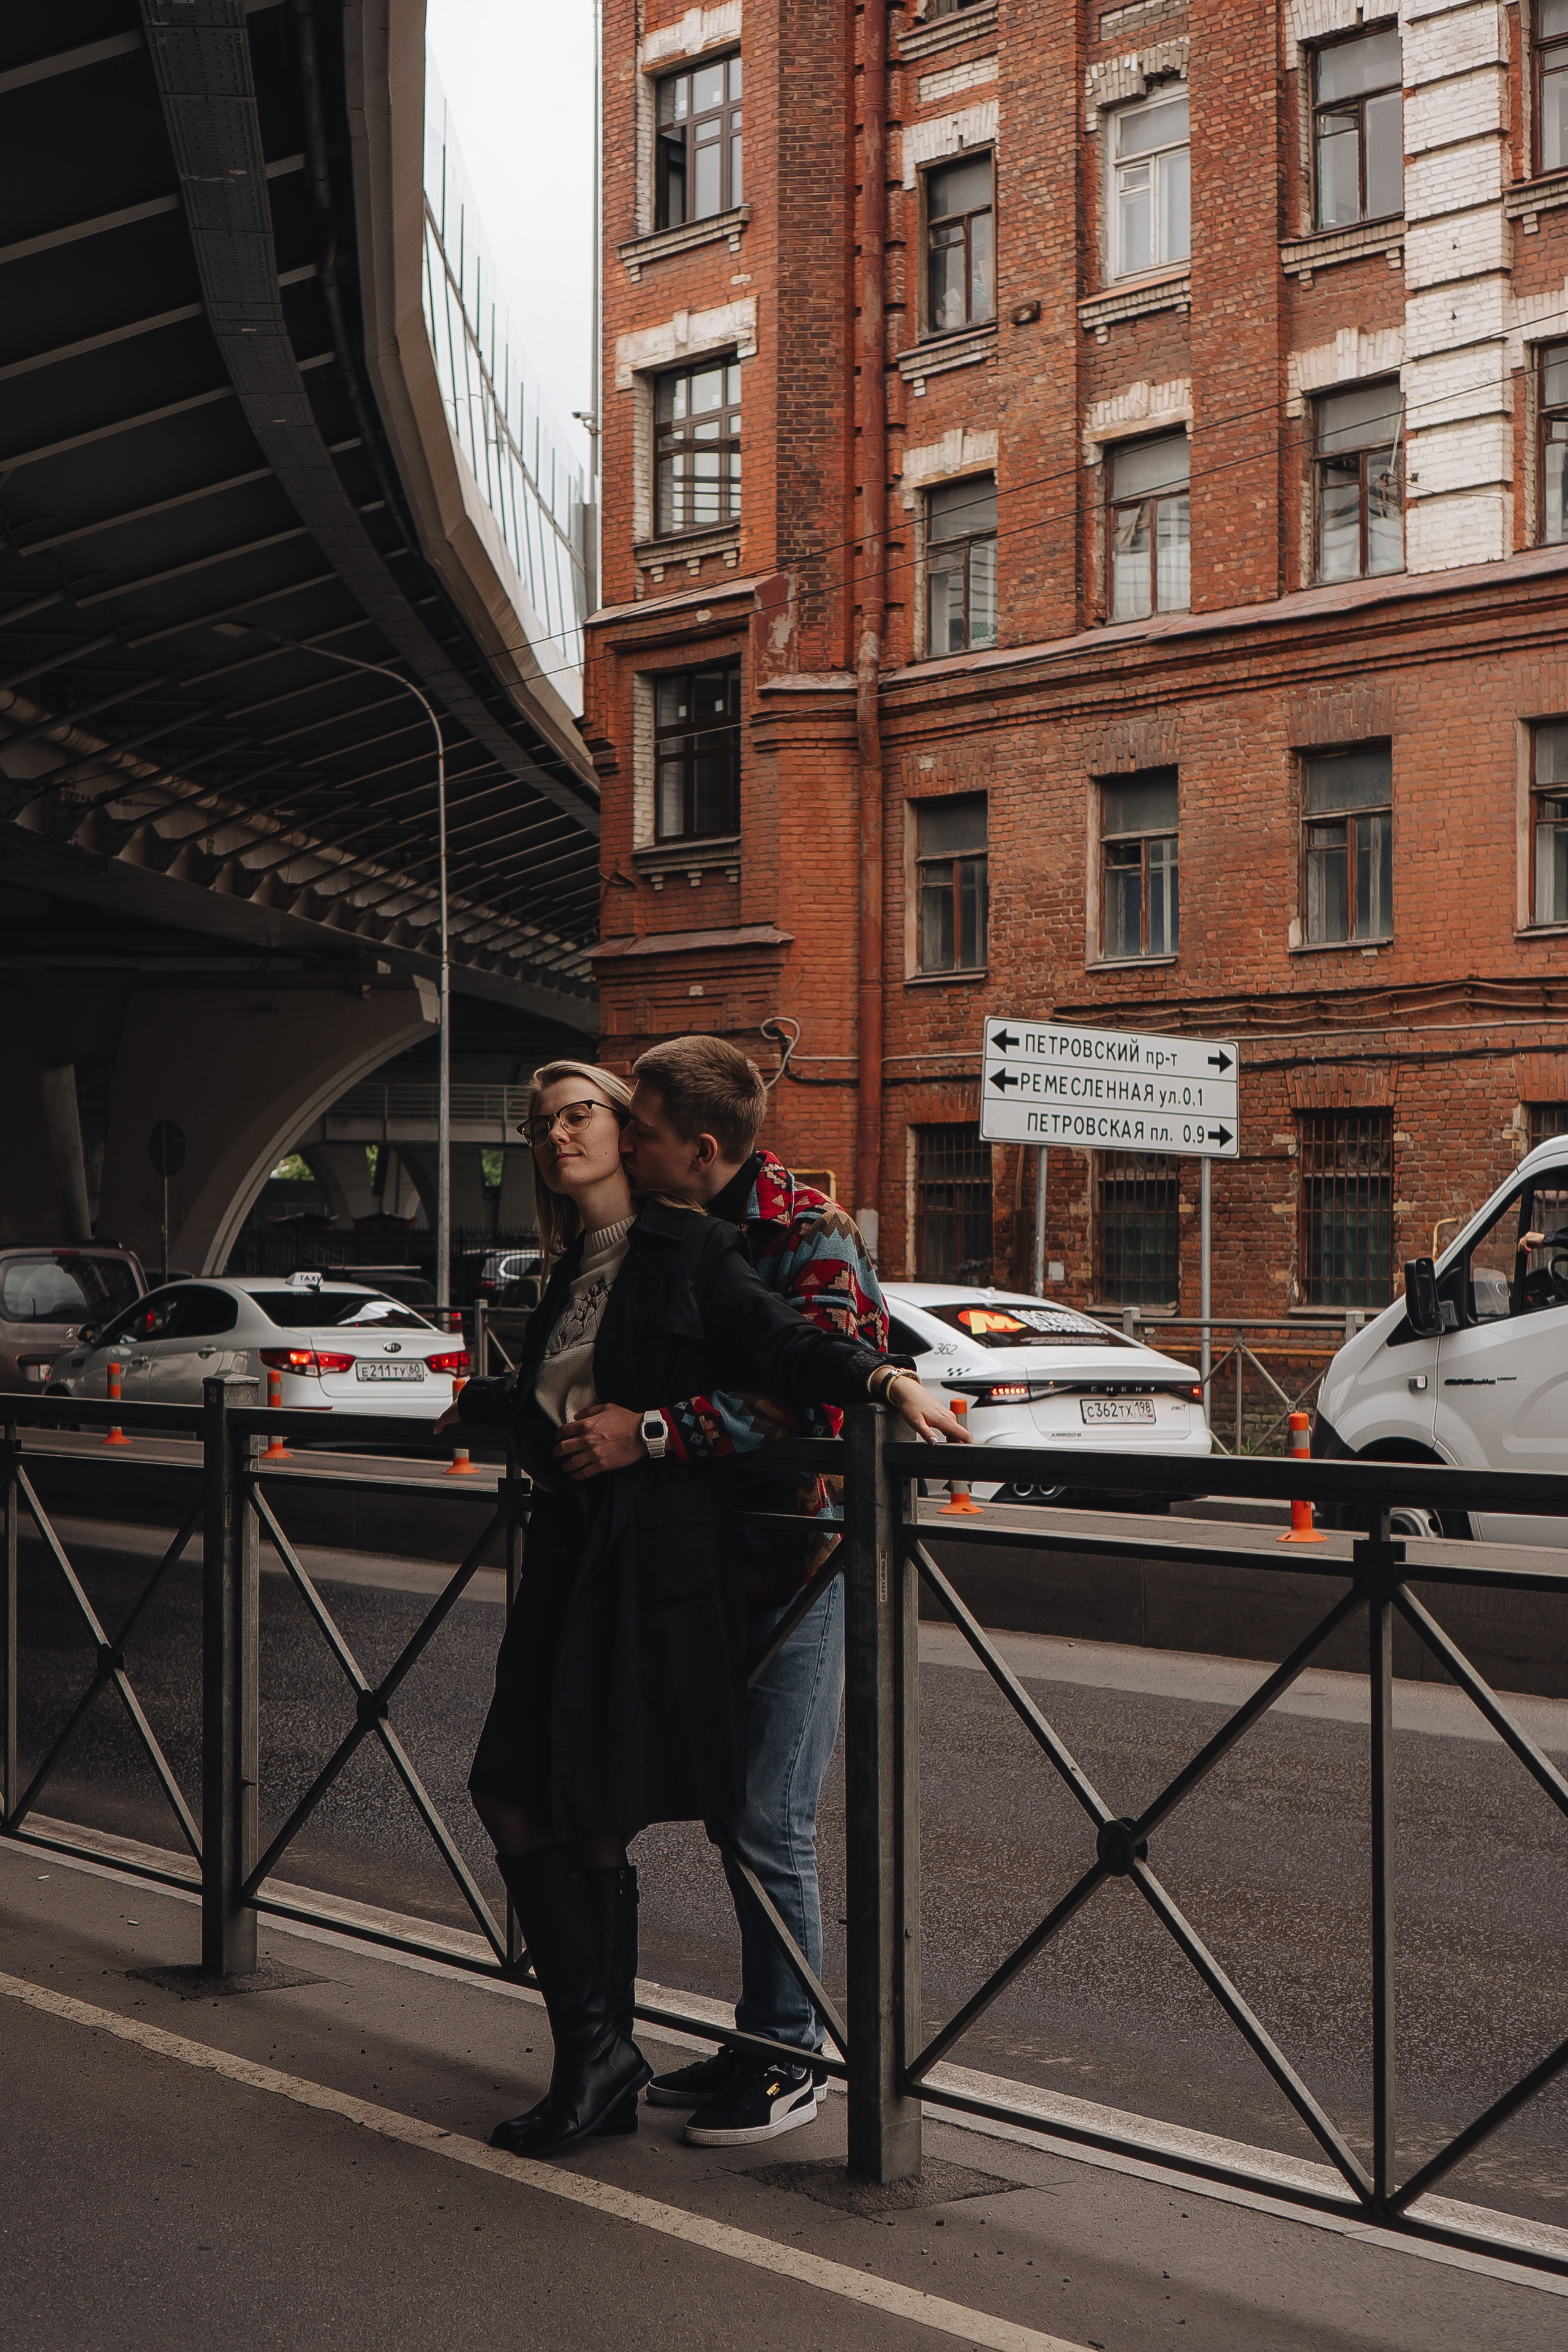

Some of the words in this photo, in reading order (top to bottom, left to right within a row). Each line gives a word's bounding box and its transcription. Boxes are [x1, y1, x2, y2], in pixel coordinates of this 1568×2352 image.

[1025, 1033, 1140, 1063] ПЕТРОВСКИЙ
[1146, 1051, 1178, 1069] пр-т
[1020, 1072, 1153, 1102] РЕМЕСЛЕННАЯ
[1027, 1112, 1144, 1139] ПЕТРОВСКАЯ
[1150, 1127, 1173, 1142] пл.
[1183, 1125, 1205, 1144] 0,9
[934, 1342, 959, 1355] 362
[1135, 1401, 1152, 1413] 198
